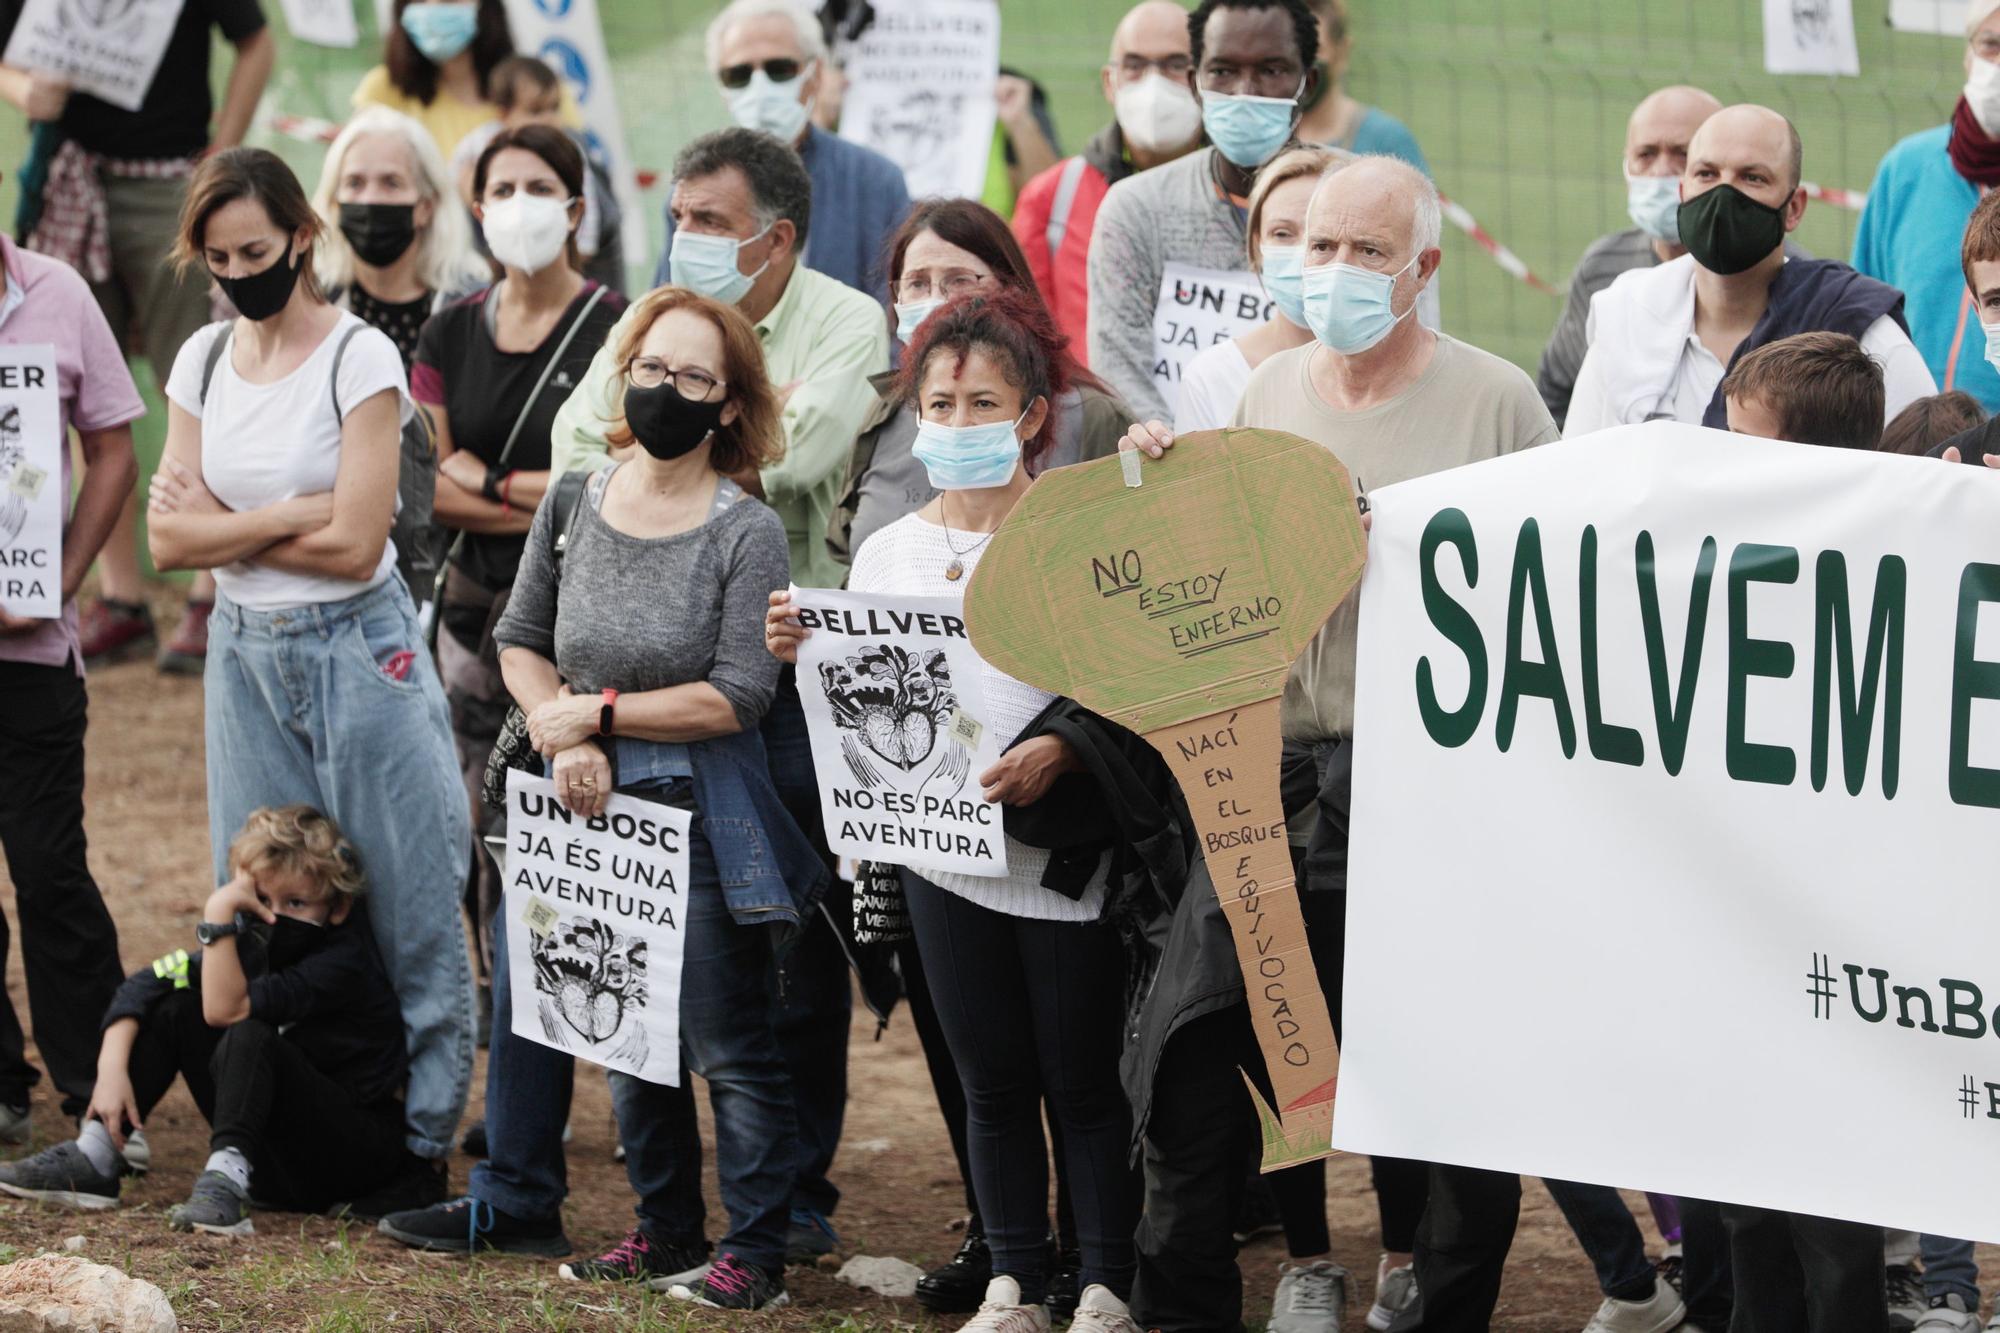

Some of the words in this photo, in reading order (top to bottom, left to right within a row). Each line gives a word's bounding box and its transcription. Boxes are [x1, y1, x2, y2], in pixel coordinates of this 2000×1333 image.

[1175, 280, 1225, 314] UN
[1161, 321, 1198, 350] JA
[1092, 550, 1142, 592] NO
[1139, 567, 1228, 610] ESTOY
[799, 608, 968, 639] BELLVER
[1169, 597, 1281, 648] ENFERMO
[1416, 507, 1907, 801] SALVEM
[1176, 713, 1239, 762] NACÍ
[1204, 767, 1234, 788] EN
[519, 791, 573, 825] UN
[833, 788, 875, 810] NO
[883, 792, 916, 814] ES
[923, 796, 992, 826] PARC
[1218, 799, 1252, 818] EL
[840, 821, 993, 860] AVENTURA
[1206, 822, 1286, 854] BOSQUE
[518, 830, 555, 861] JA
[565, 838, 601, 872] ÉS
[612, 855, 678, 894] UNA
[515, 868, 677, 930] AVENTURA
[1806, 951, 2000, 1040] #UnB
